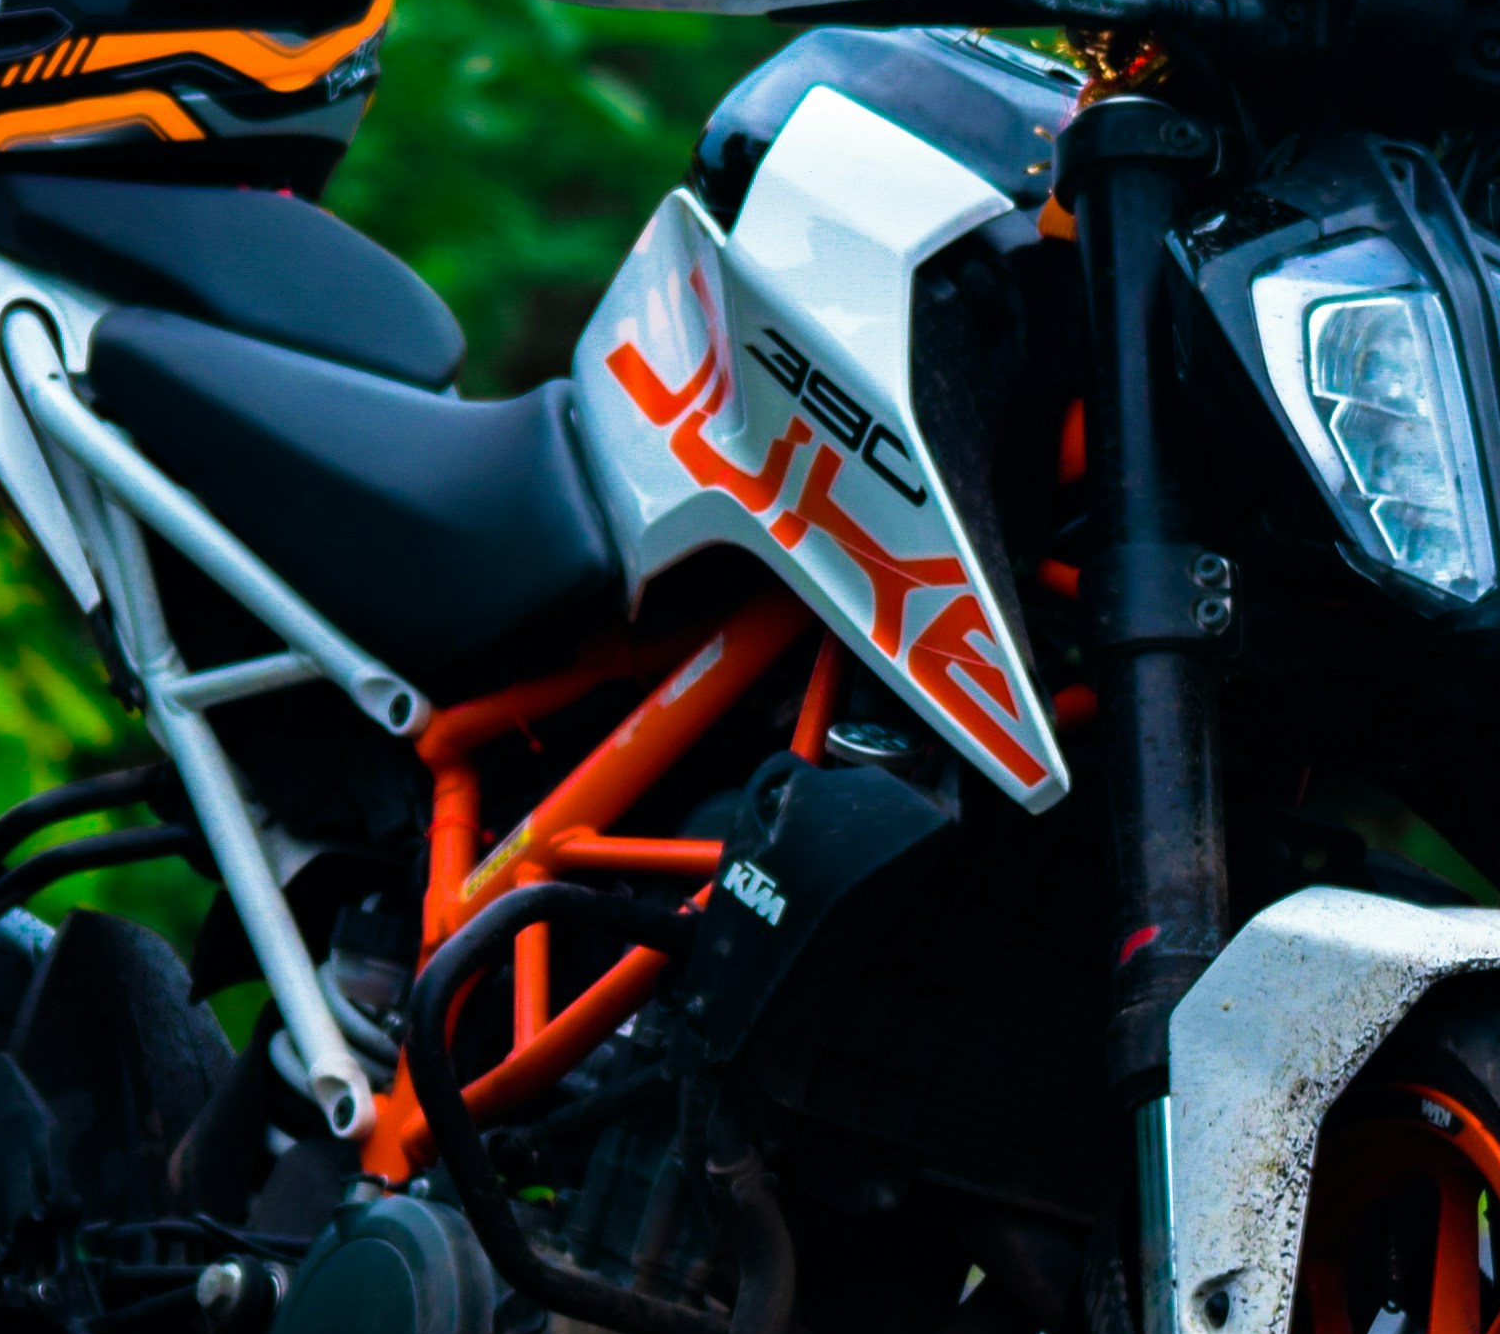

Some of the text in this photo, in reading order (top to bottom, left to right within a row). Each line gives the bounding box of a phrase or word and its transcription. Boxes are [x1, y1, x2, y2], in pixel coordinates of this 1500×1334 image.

[744, 328, 928, 507] 390
[605, 267, 1048, 788] DUKE
[723, 861, 785, 926] KTM
